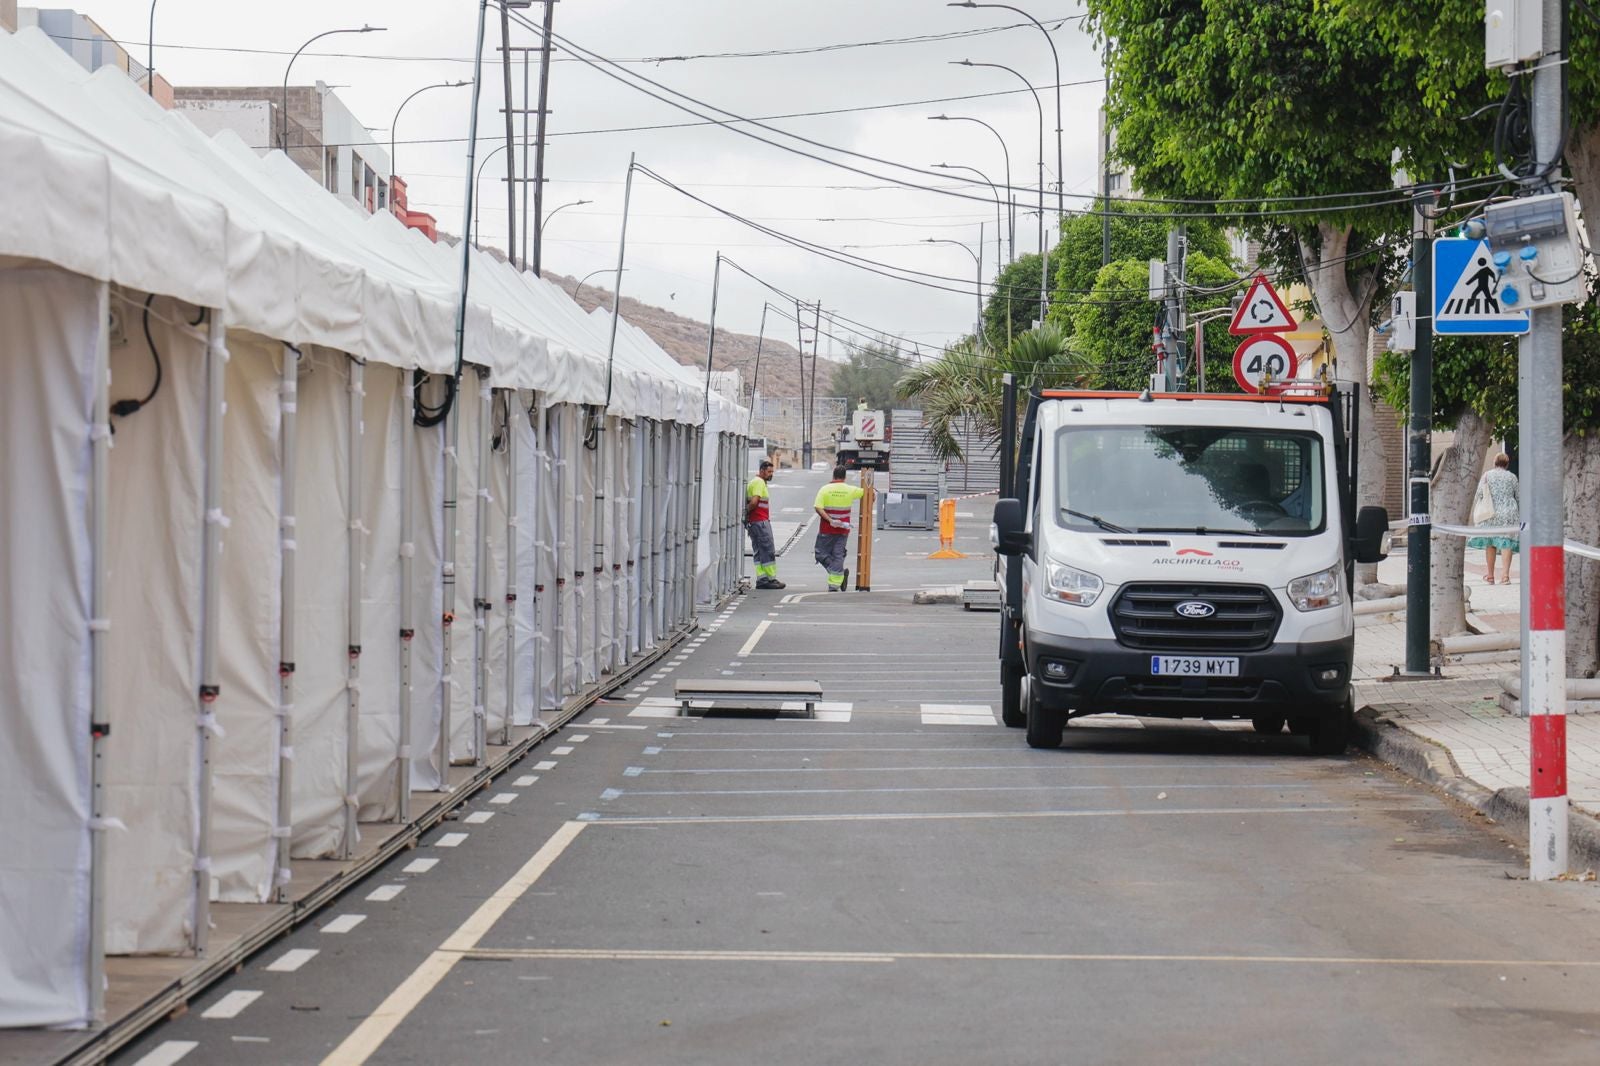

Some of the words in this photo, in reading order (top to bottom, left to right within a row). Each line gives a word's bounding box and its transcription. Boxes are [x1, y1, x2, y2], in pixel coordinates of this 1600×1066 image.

[1247, 354, 1284, 376] 40
[1183, 604, 1207, 615] Ford
[1164, 659, 1201, 673] 1739
[1206, 660, 1235, 674] MYT
